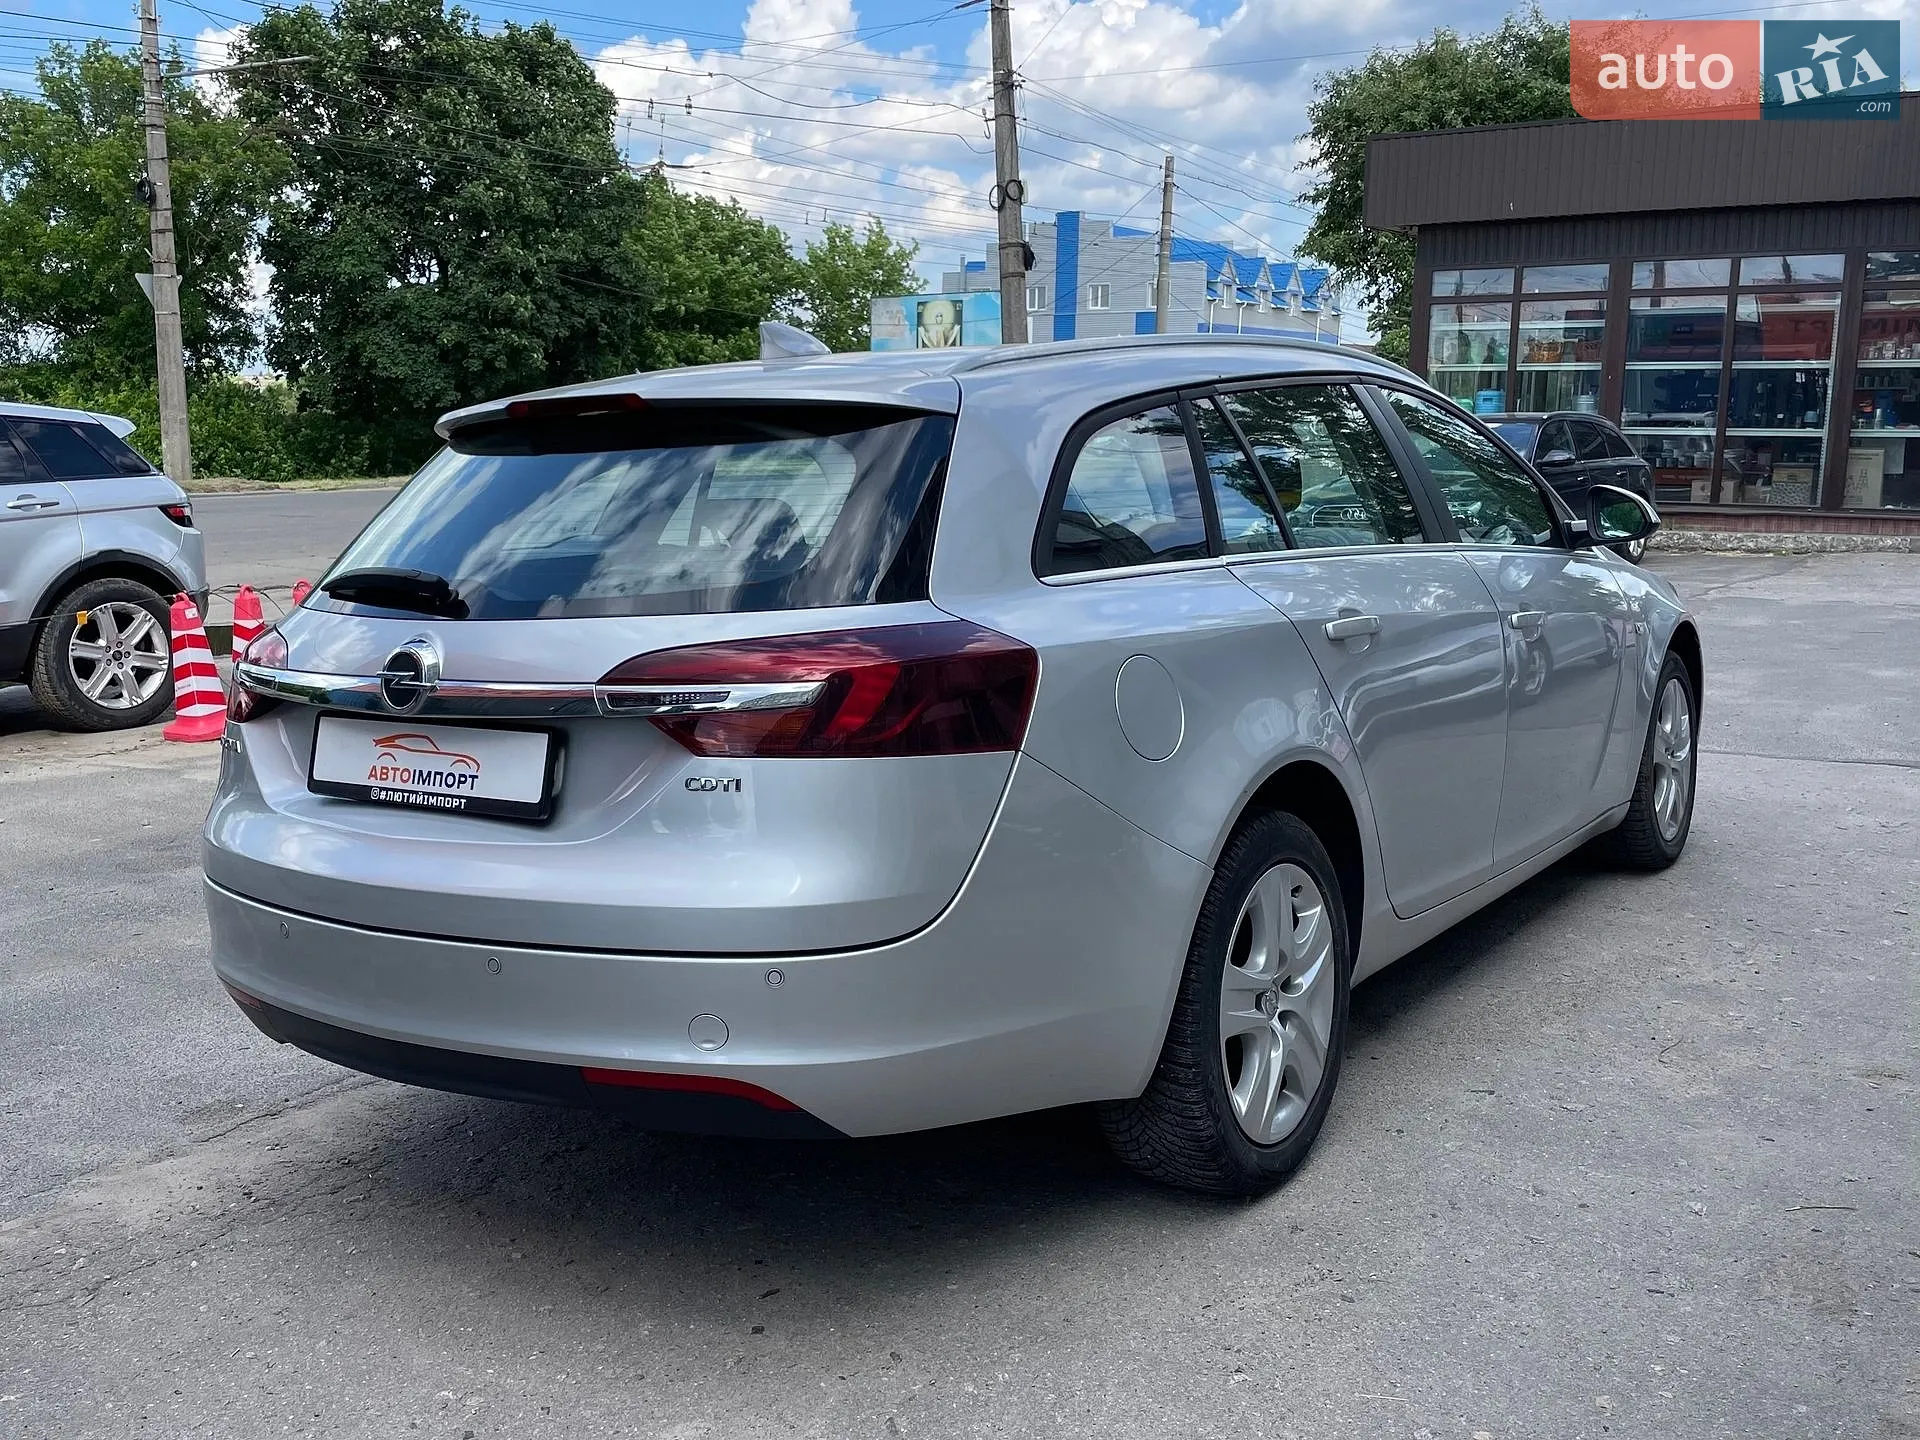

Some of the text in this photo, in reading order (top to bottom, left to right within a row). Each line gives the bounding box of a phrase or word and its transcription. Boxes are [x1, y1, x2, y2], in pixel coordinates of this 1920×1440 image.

[367, 764, 479, 791] АВТОІМПОРТ
[684, 777, 742, 793] CDTI
[379, 789, 467, 810] #ЛЮТИЙІМПОРТ
